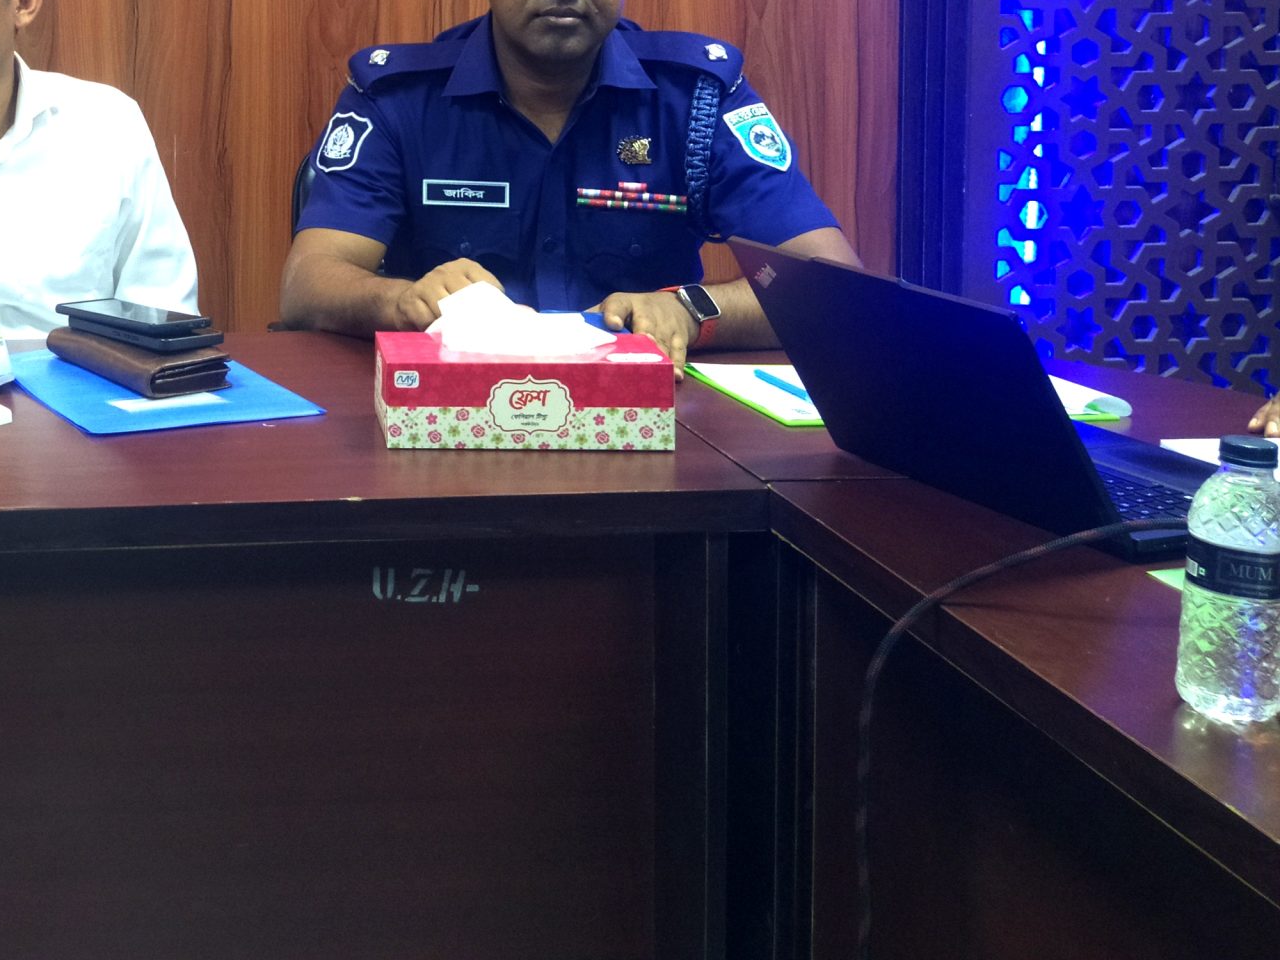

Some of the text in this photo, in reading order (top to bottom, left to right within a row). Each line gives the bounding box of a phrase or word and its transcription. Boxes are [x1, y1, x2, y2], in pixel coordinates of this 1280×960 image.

[443, 188, 485, 199] জাকির
[509, 389, 551, 410] ফ্রেশ
[1230, 563, 1272, 581] MUM
